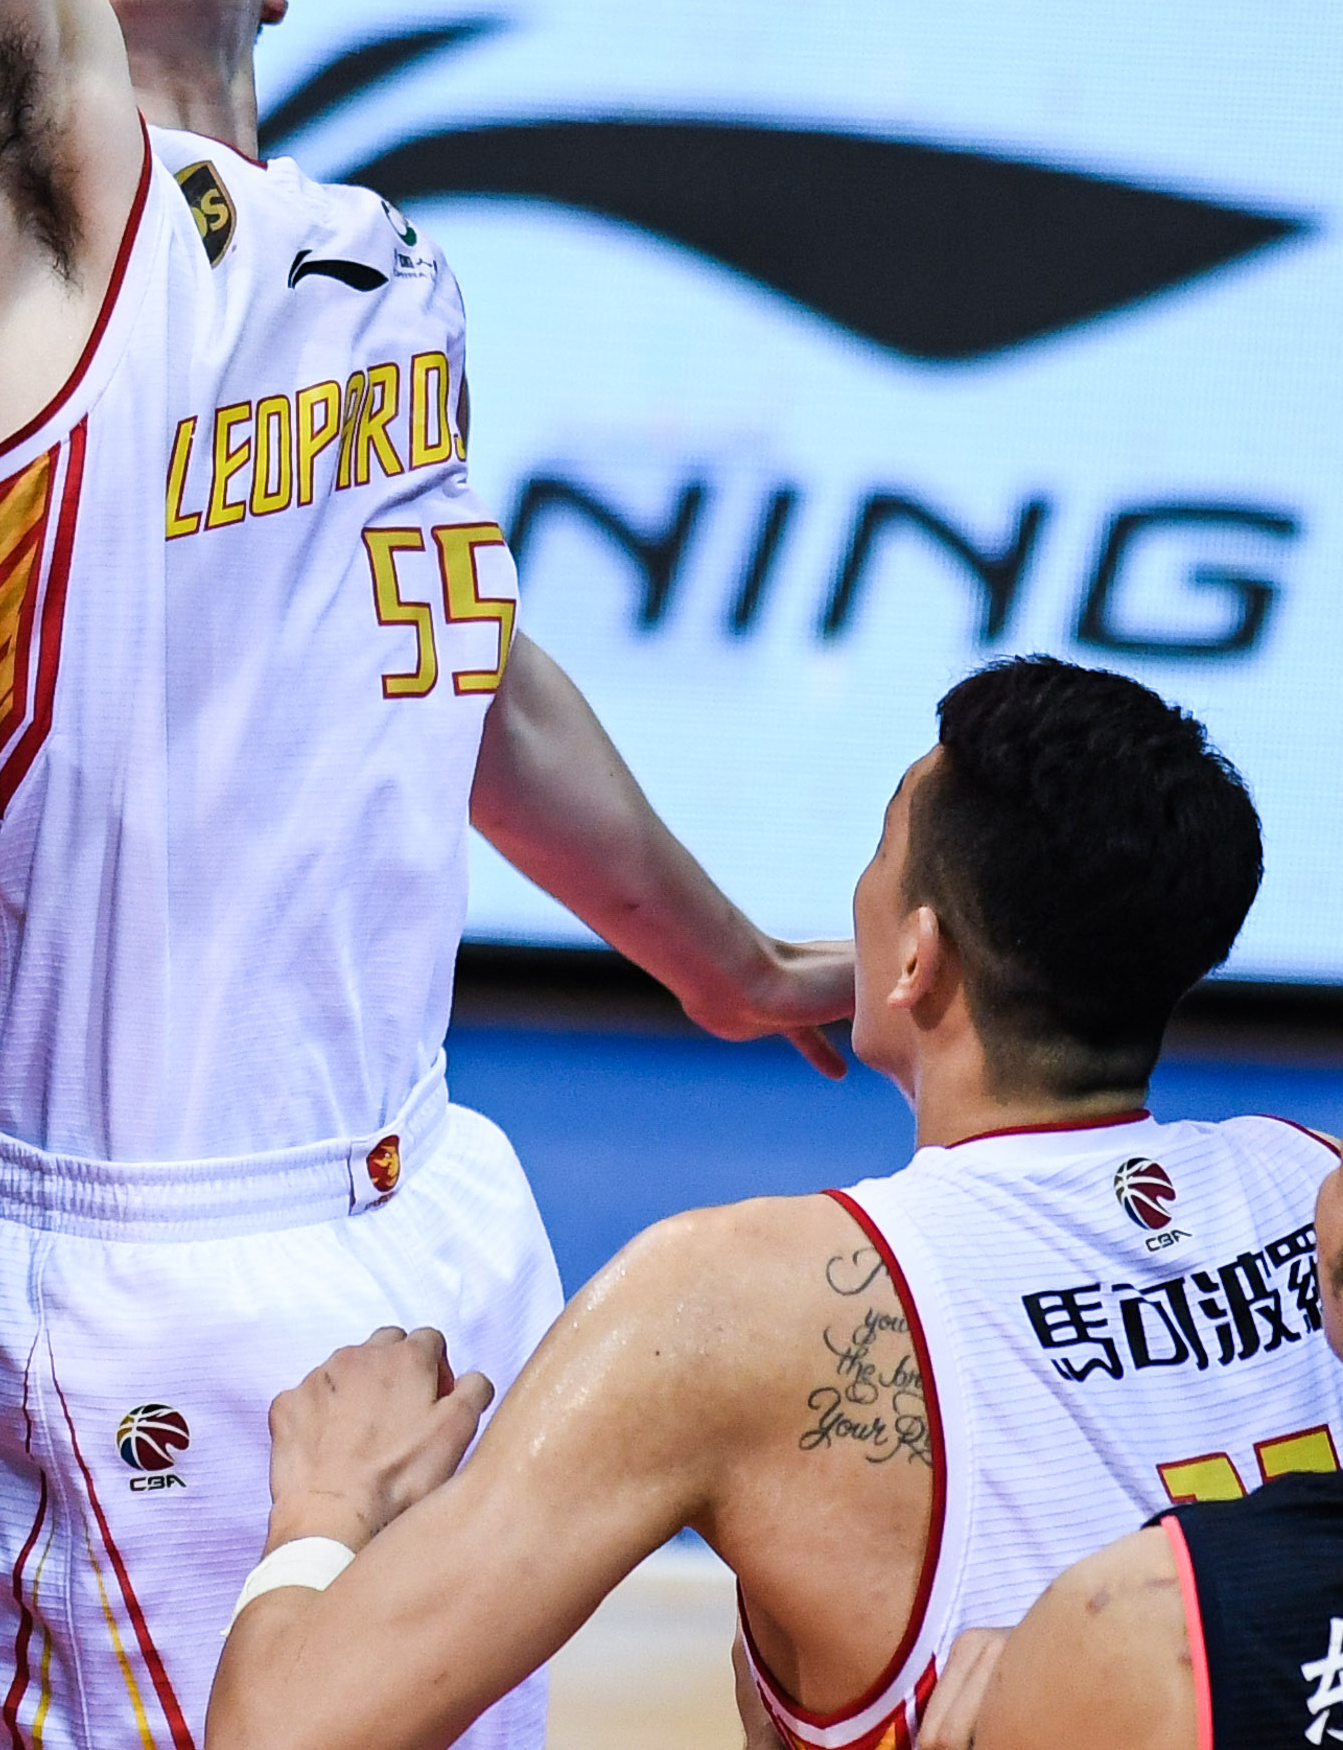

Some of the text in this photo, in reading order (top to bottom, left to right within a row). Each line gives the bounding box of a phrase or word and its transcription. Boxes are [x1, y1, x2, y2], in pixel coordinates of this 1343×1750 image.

[164, 349, 467, 542] LEOPARD
[361, 520, 518, 700] 55
[1145, 1228, 1193, 1253] CBA
[129, 1473, 188, 1493] CBA
